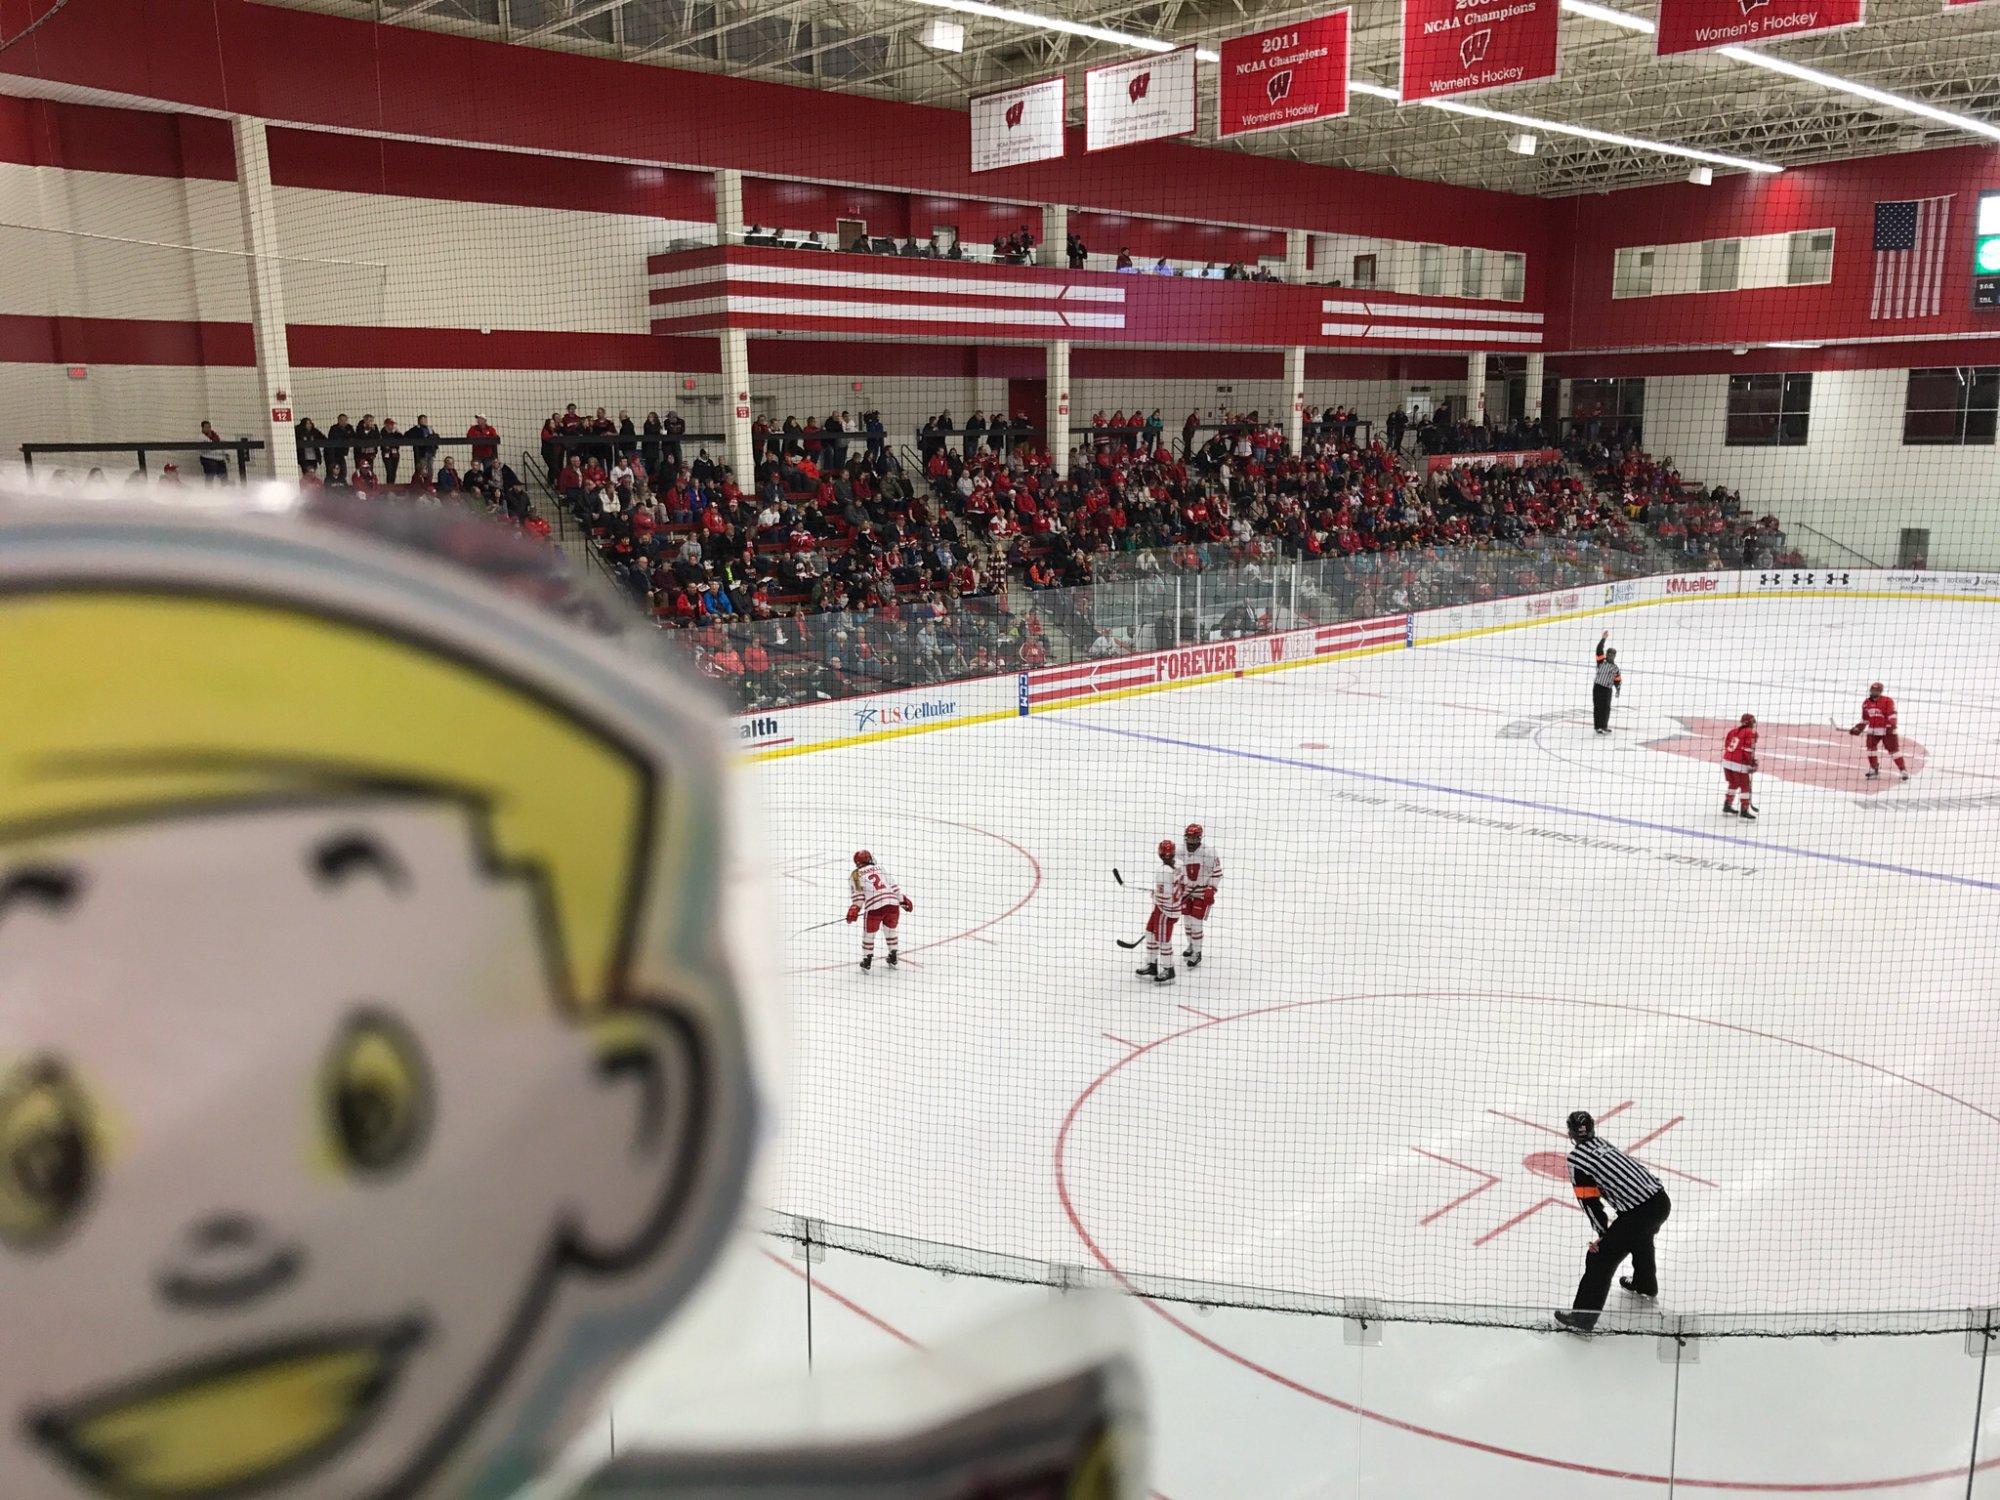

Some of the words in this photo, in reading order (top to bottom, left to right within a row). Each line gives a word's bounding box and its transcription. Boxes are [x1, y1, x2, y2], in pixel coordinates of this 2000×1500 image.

[1424, 17, 1460, 34] NCAA
[1464, 2, 1536, 26] Champions
[1695, 20, 1759, 41] Women's
[1763, 12, 1818, 30] Hockey
[1262, 32, 1299, 53] 2011
[1236, 60, 1266, 75] NCAA
[1269, 47, 1328, 67] Champions
[1430, 74, 1479, 93] Women's
[1482, 67, 1525, 83] Hockey
[1242, 109, 1283, 125] Women's
[1285, 103, 1319, 119] Hockey
[277, 413, 287, 421] 12
[1671, 577, 1719, 592] Mueller
[1157, 645, 1237, 681] FOREVER
[1238, 632, 1314, 668] FORWARD
[1020, 675, 1028, 707] CCM
[904, 700, 956, 720] Cellular
[740, 717, 777, 738] alth
[868, 874, 886, 890] 2
